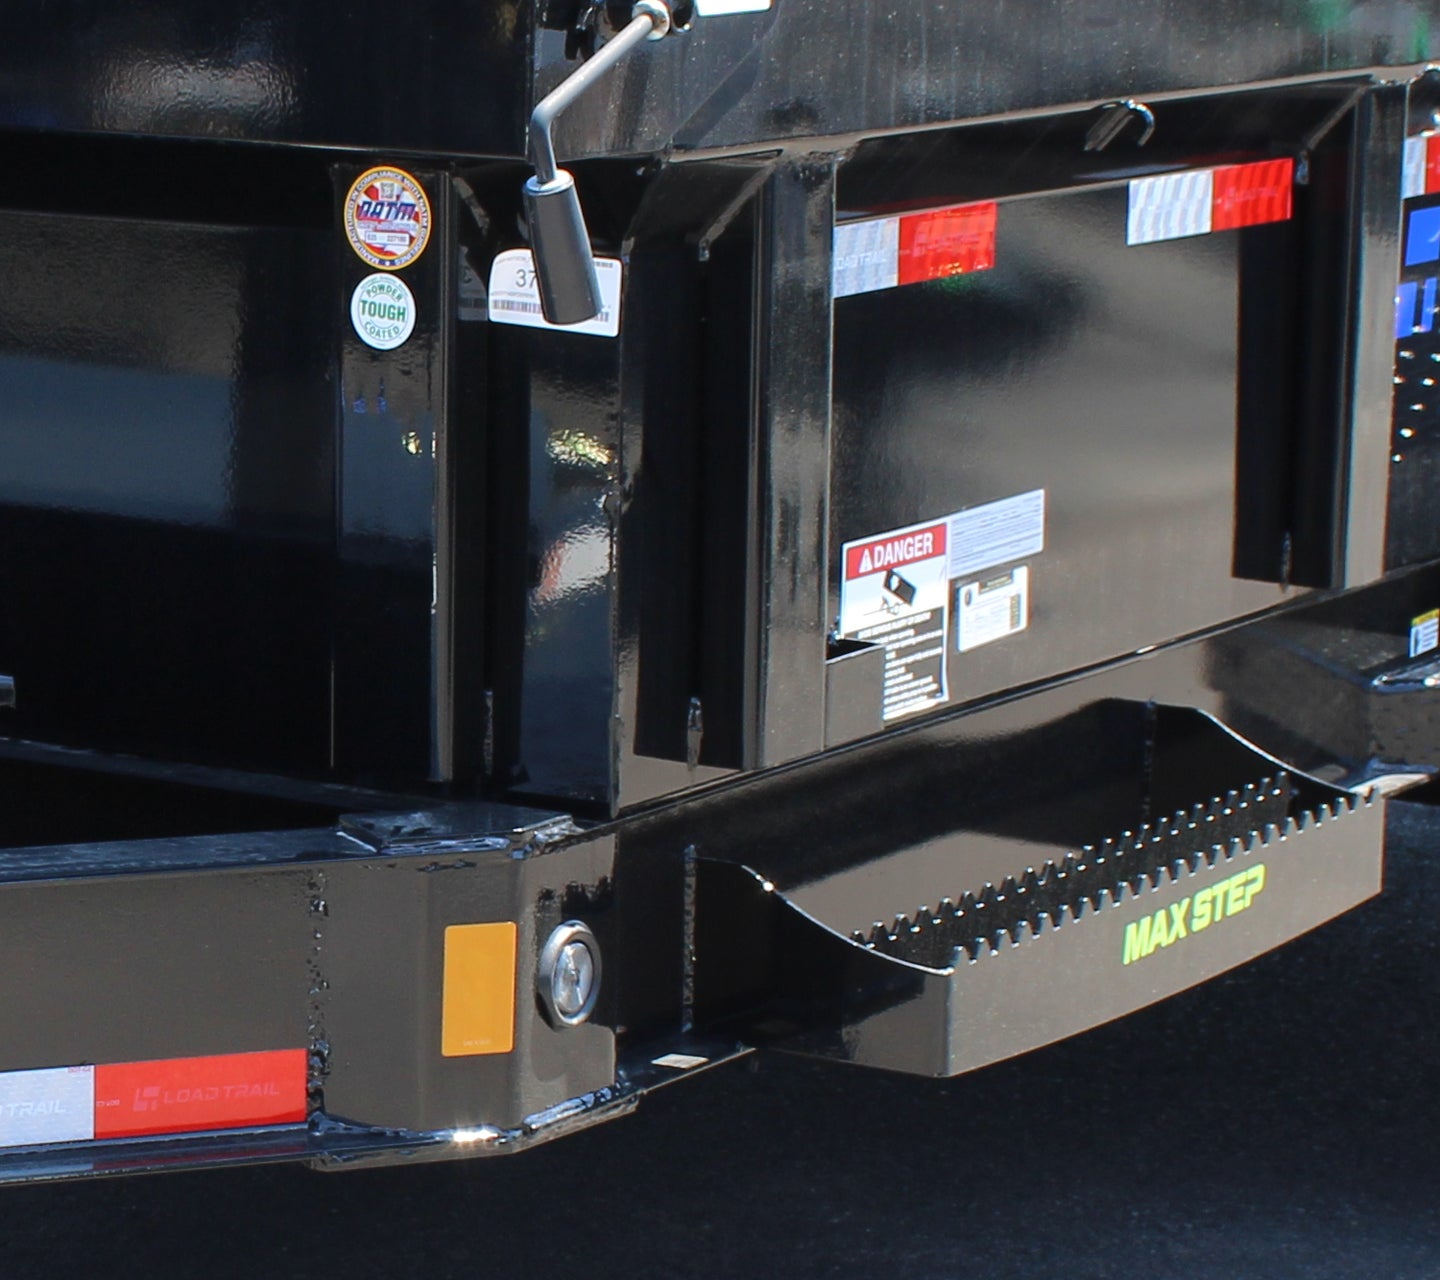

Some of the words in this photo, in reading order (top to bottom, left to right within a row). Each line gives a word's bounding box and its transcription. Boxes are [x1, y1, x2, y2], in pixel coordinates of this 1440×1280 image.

[366, 283, 403, 302] POWDER
[360, 299, 407, 323] TOUGH
[363, 321, 401, 340] COATED
[873, 531, 934, 569] DANGER
[1122, 897, 1191, 965] MAX
[1191, 863, 1266, 933] STEP
[163, 1087, 219, 1106] LOAD
[219, 1081, 281, 1099] TRAIL
[8, 1098, 66, 1118] TRAIL
